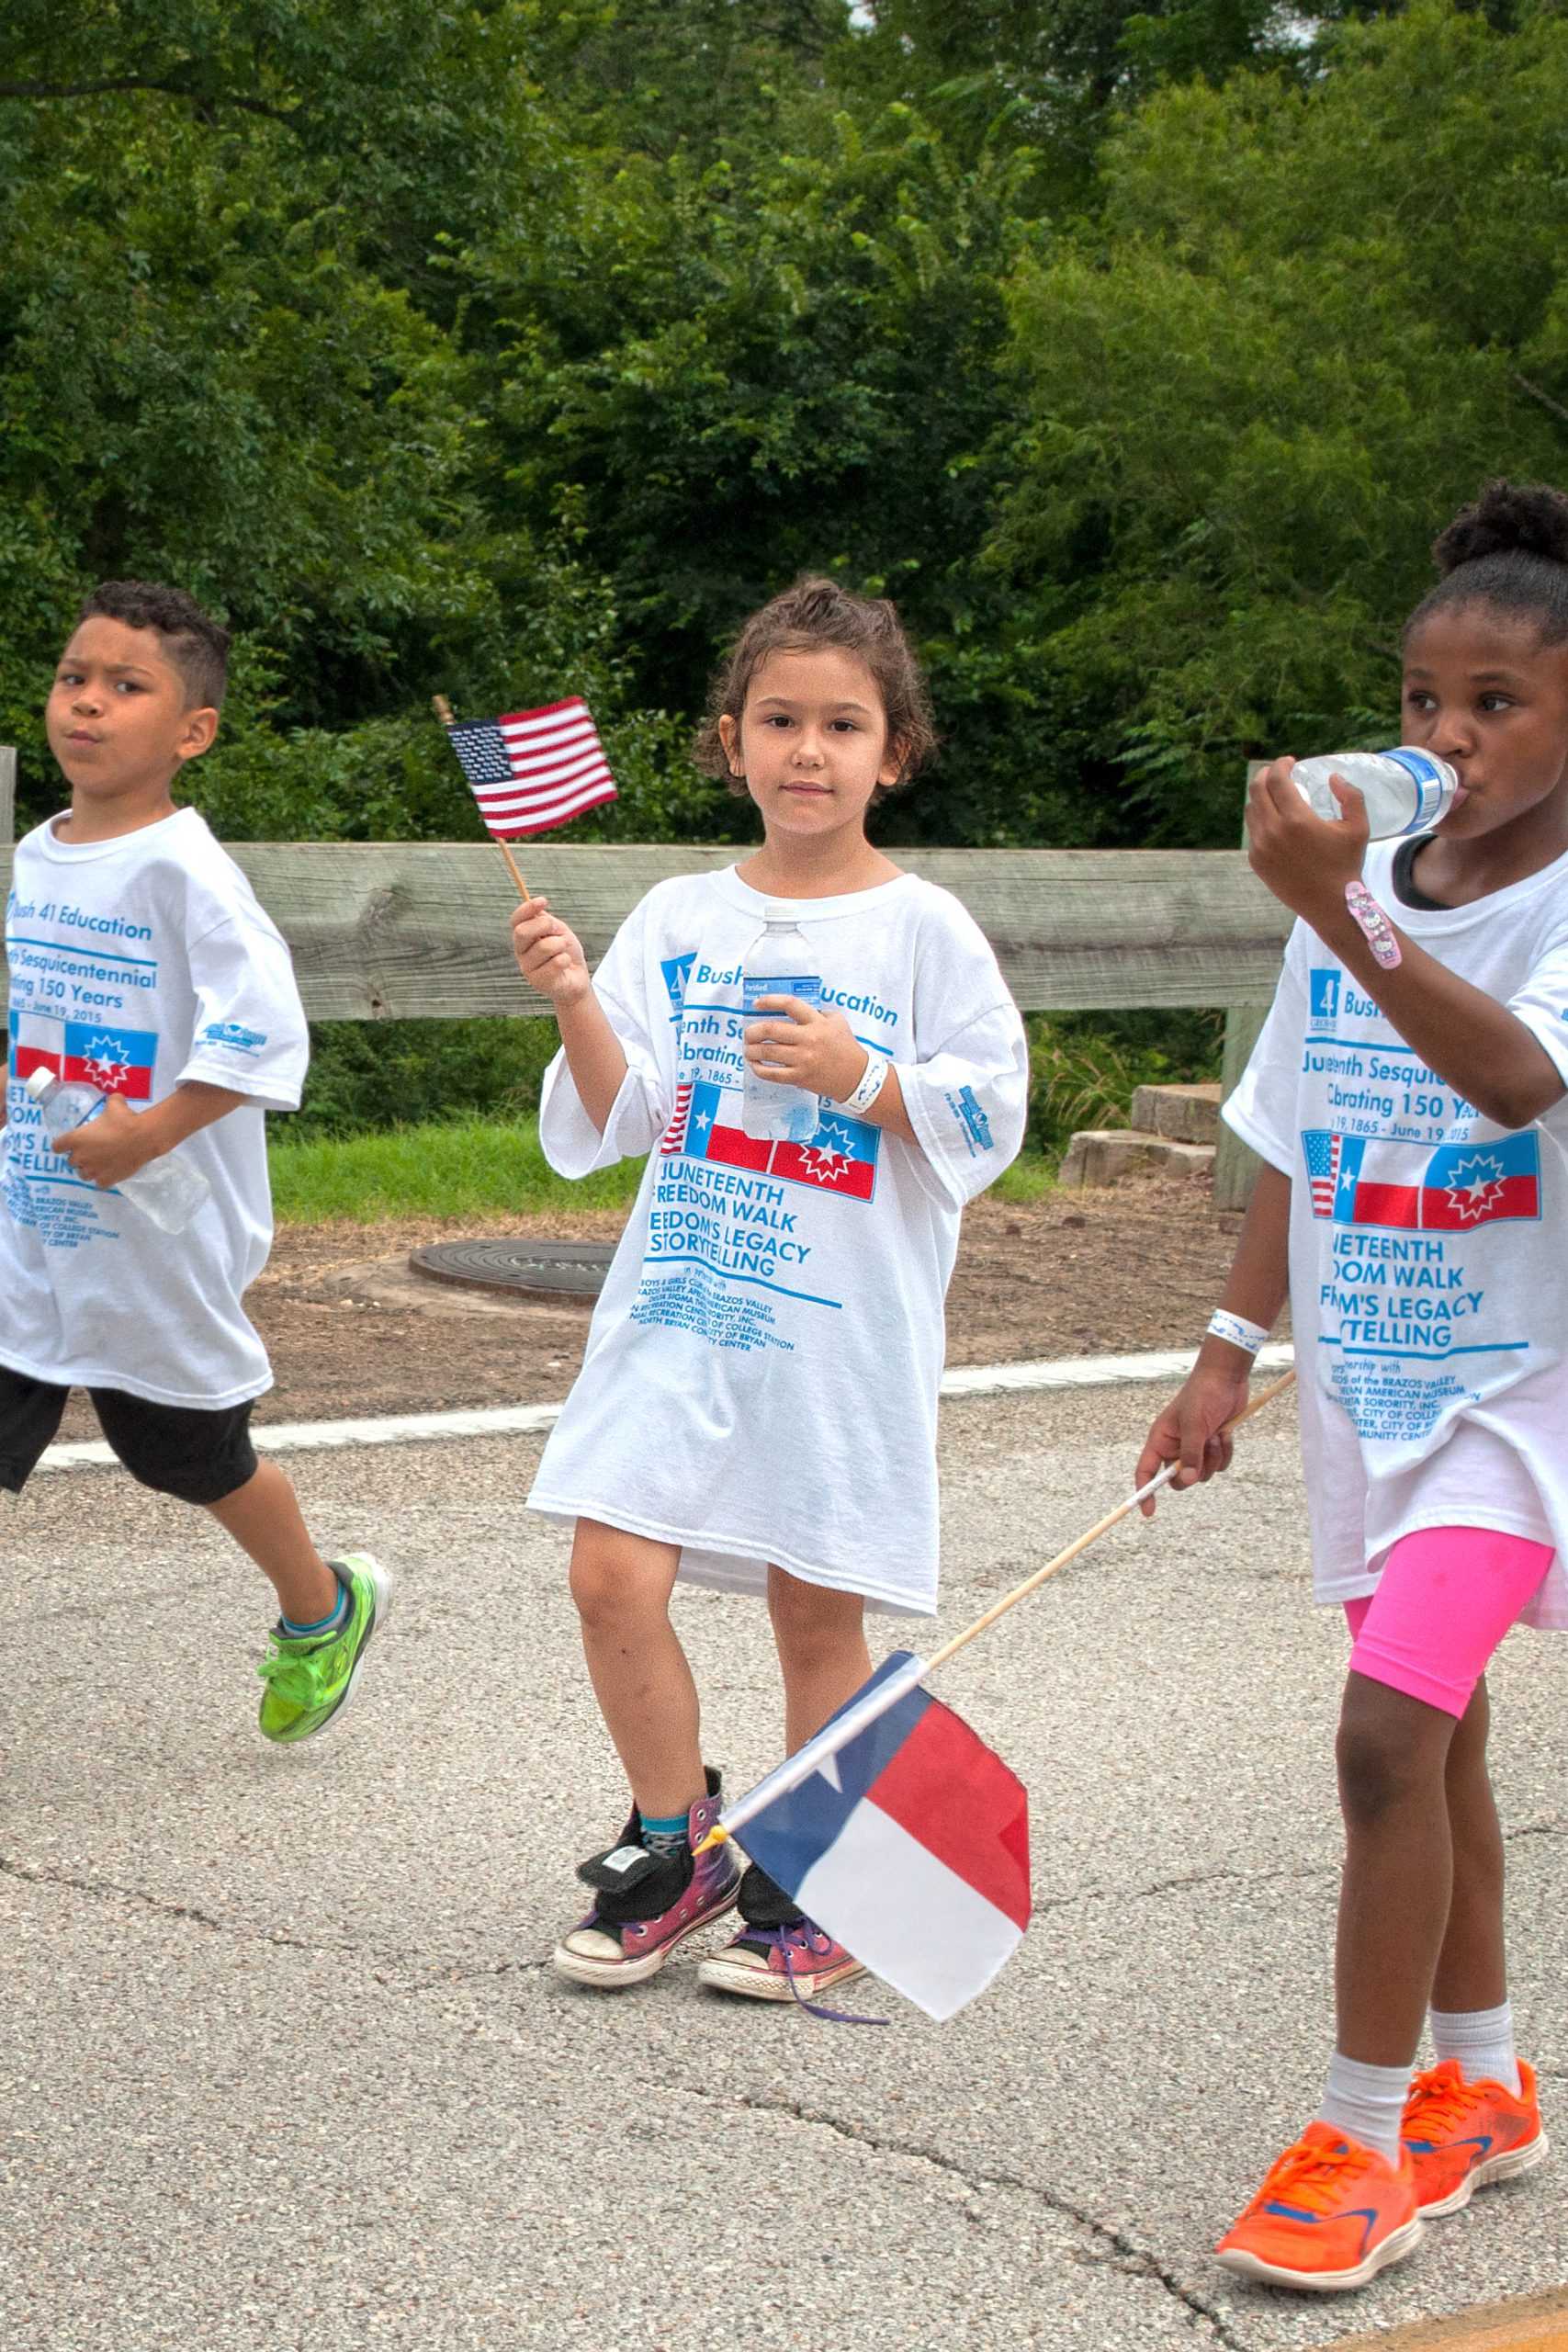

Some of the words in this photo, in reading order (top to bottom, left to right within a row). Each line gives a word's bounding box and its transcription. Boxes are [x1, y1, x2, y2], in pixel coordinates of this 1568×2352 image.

[14, 901, 35, 919] ush
[39, 903, 56, 922] 41
[58, 906, 152, 941] Education
[20, 949, 157, 989] Sesquicentennial
[39, 978, 65, 999] 150
[71, 984, 123, 1009] Years
[820, 986, 898, 1026] ucation
[73, 1009, 102, 1023] 2015
[678, 1042, 744, 1071] brating
[708, 1069, 733, 1084] 1865
[1328, 1082, 1394, 1118] brating
[1403, 1093, 1444, 1118] 150
[1351, 1118, 1378, 1134] 1865
[1391, 1123, 1421, 1138] June
[661, 1159, 784, 1206] JUNETEENTH
[653, 1183, 727, 1216] REEDOM
[733, 1199, 798, 1233] WALK
[649, 1210, 721, 1240] EEDOM'S
[724, 1226, 812, 1265] LEGACY
[1393, 1266, 1464, 1289] WALK
[668, 1293, 693, 1305] SIGMA
[745, 1299, 773, 1314] VALLEY
[1387, 1290, 1484, 1321] LEGACY
[741, 1307, 776, 1325] MUSEUM
[718, 1339, 751, 1351] CENTER
[725, 1322, 762, 1338] COLLEGE
[763, 1331, 795, 1351] STATION
[739, 1332, 766, 1348] BRYAN
[1381, 1361, 1401, 1374] with
[1351, 1375, 1361, 1384] of
[1364, 1375, 1379, 1385] the
[1382, 1377, 1423, 1389] BRAZOS
[1366, 1385, 1422, 1399] AMERICAN
[1423, 1384, 1466, 1399] MUSEUM
[1364, 1396, 1416, 1410] SORORITY,
[1363, 1408, 1385, 1419] CITY
[1387, 1409, 1402, 1420] OF
[1381, 1420, 1404, 1430] CITY
[1406, 1420, 1422, 1430] OF
[1359, 1429, 1397, 1441] MUNITY
